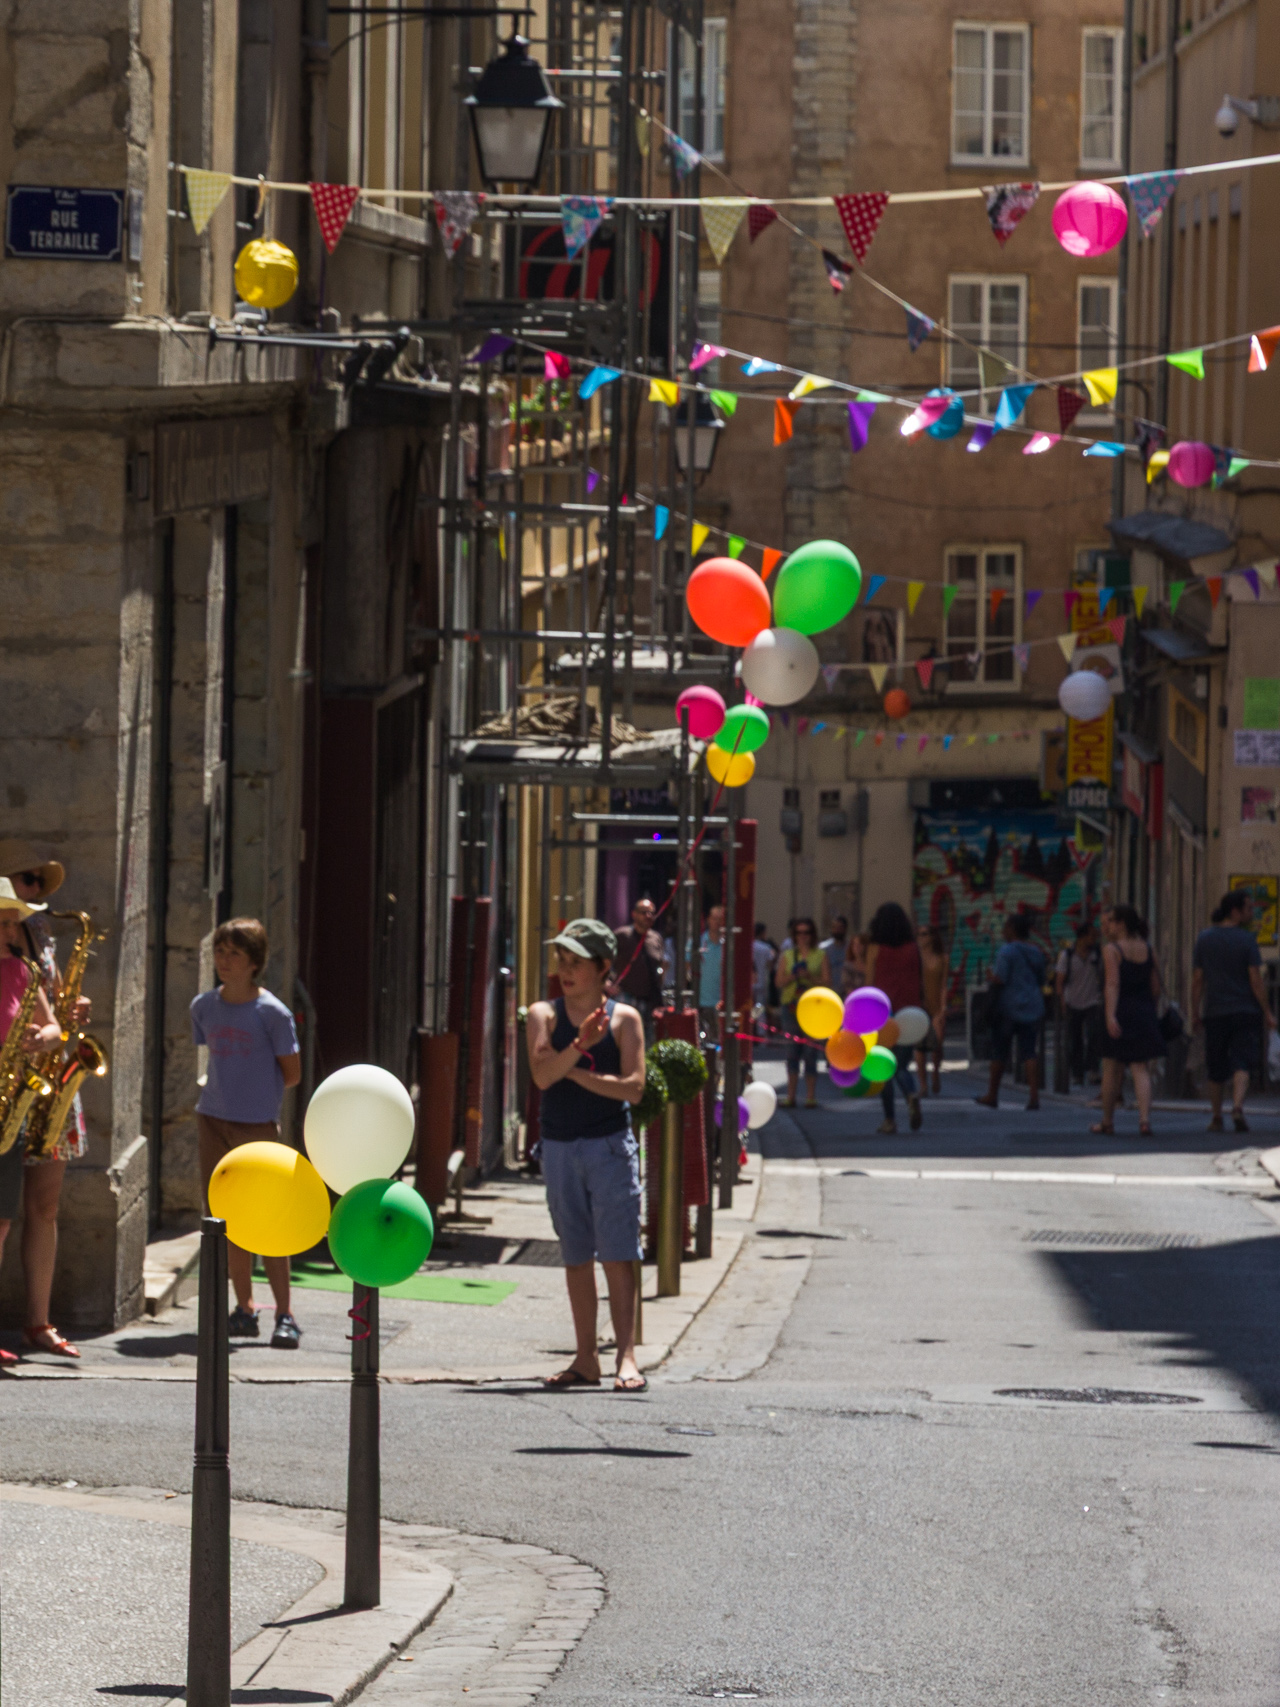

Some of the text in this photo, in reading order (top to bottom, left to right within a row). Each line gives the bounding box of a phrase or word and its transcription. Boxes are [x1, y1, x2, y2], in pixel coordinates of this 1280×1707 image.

[51, 210, 78, 228] RUE
[30, 231, 99, 250] TERRAILLE
[1069, 788, 1108, 807] ESPACE
